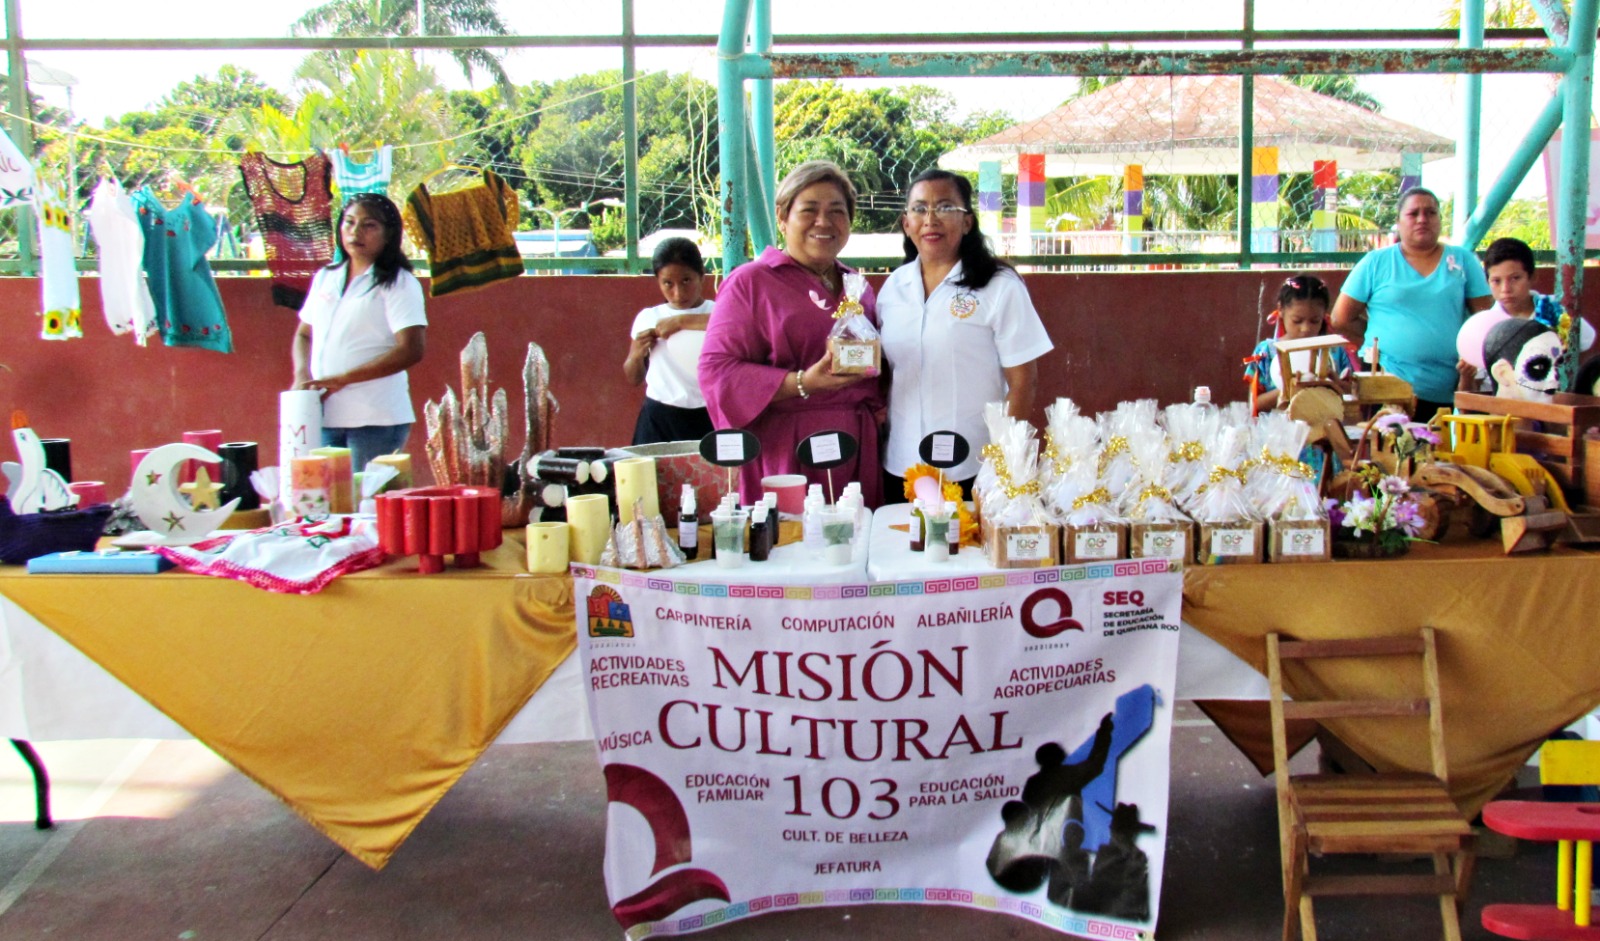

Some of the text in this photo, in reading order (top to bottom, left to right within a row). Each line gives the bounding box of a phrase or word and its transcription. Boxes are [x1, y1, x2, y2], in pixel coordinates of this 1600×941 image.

[1103, 590, 1145, 607] SEQ
[655, 606, 752, 631] CARPINTERÍA
[781, 611, 895, 633] COMPUTACIÓN
[917, 602, 1014, 628] ALBAÑILERÍA
[1103, 607, 1154, 619] SECRETARÍA
[1117, 614, 1165, 627] EDUCACIÓN
[1117, 623, 1159, 635] QUINTANA
[1161, 623, 1180, 632] ROO
[590, 656, 686, 674] ACTIVIDADES
[706, 640, 968, 702] MISIÓN
[1009, 658, 1104, 682] ACTIVIDADES
[591, 672, 690, 691] RECREATIVAS
[993, 669, 1117, 700] AGROPECUARÍAS
[658, 699, 1023, 762] CULTURAL
[598, 730, 653, 752] MÚSICA
[685, 773, 771, 789] EDUCACIÓN
[919, 774, 1005, 793] EDUCACIÓN
[697, 788, 765, 804] FAMILIAR
[783, 774, 900, 820] 103
[909, 785, 1020, 808] PARA LA SALUD
[782, 829, 909, 844] CULT. DE BELLEZA
[813, 859, 882, 875] JEFATURA
